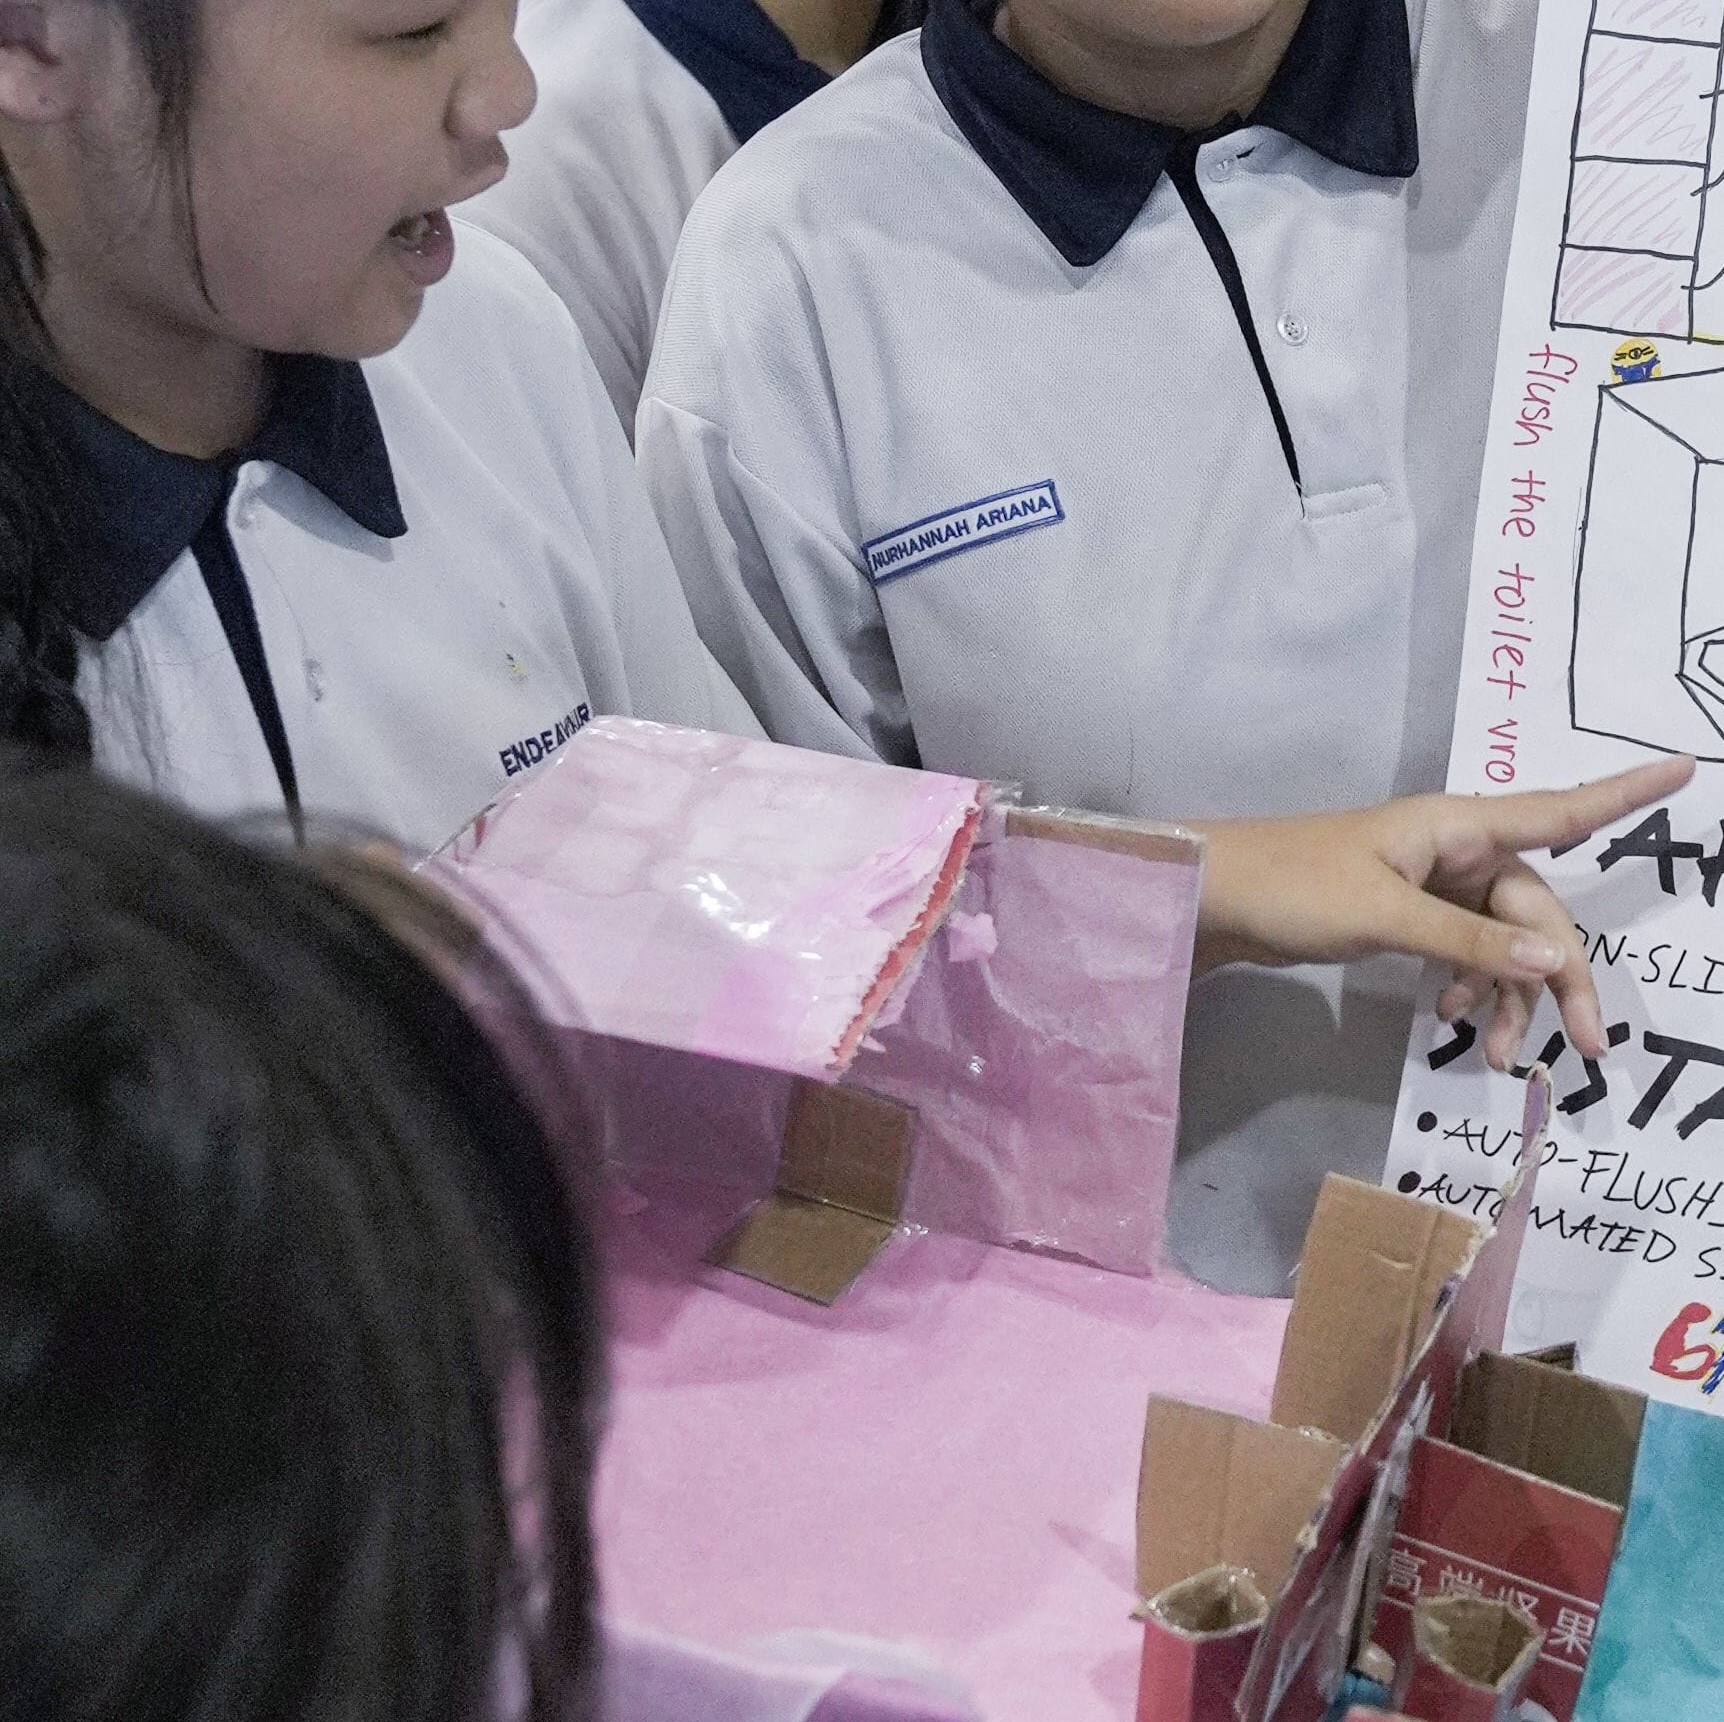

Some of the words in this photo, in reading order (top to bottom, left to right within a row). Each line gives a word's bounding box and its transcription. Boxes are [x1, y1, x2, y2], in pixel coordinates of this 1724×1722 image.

[1513, 343, 1578, 446] flush
[871, 519, 971, 571] NURHANNAH
[976, 495, 1052, 530] ARIANA
[1502, 476, 1547, 538] the
[1487, 563, 1535, 700] toilet
